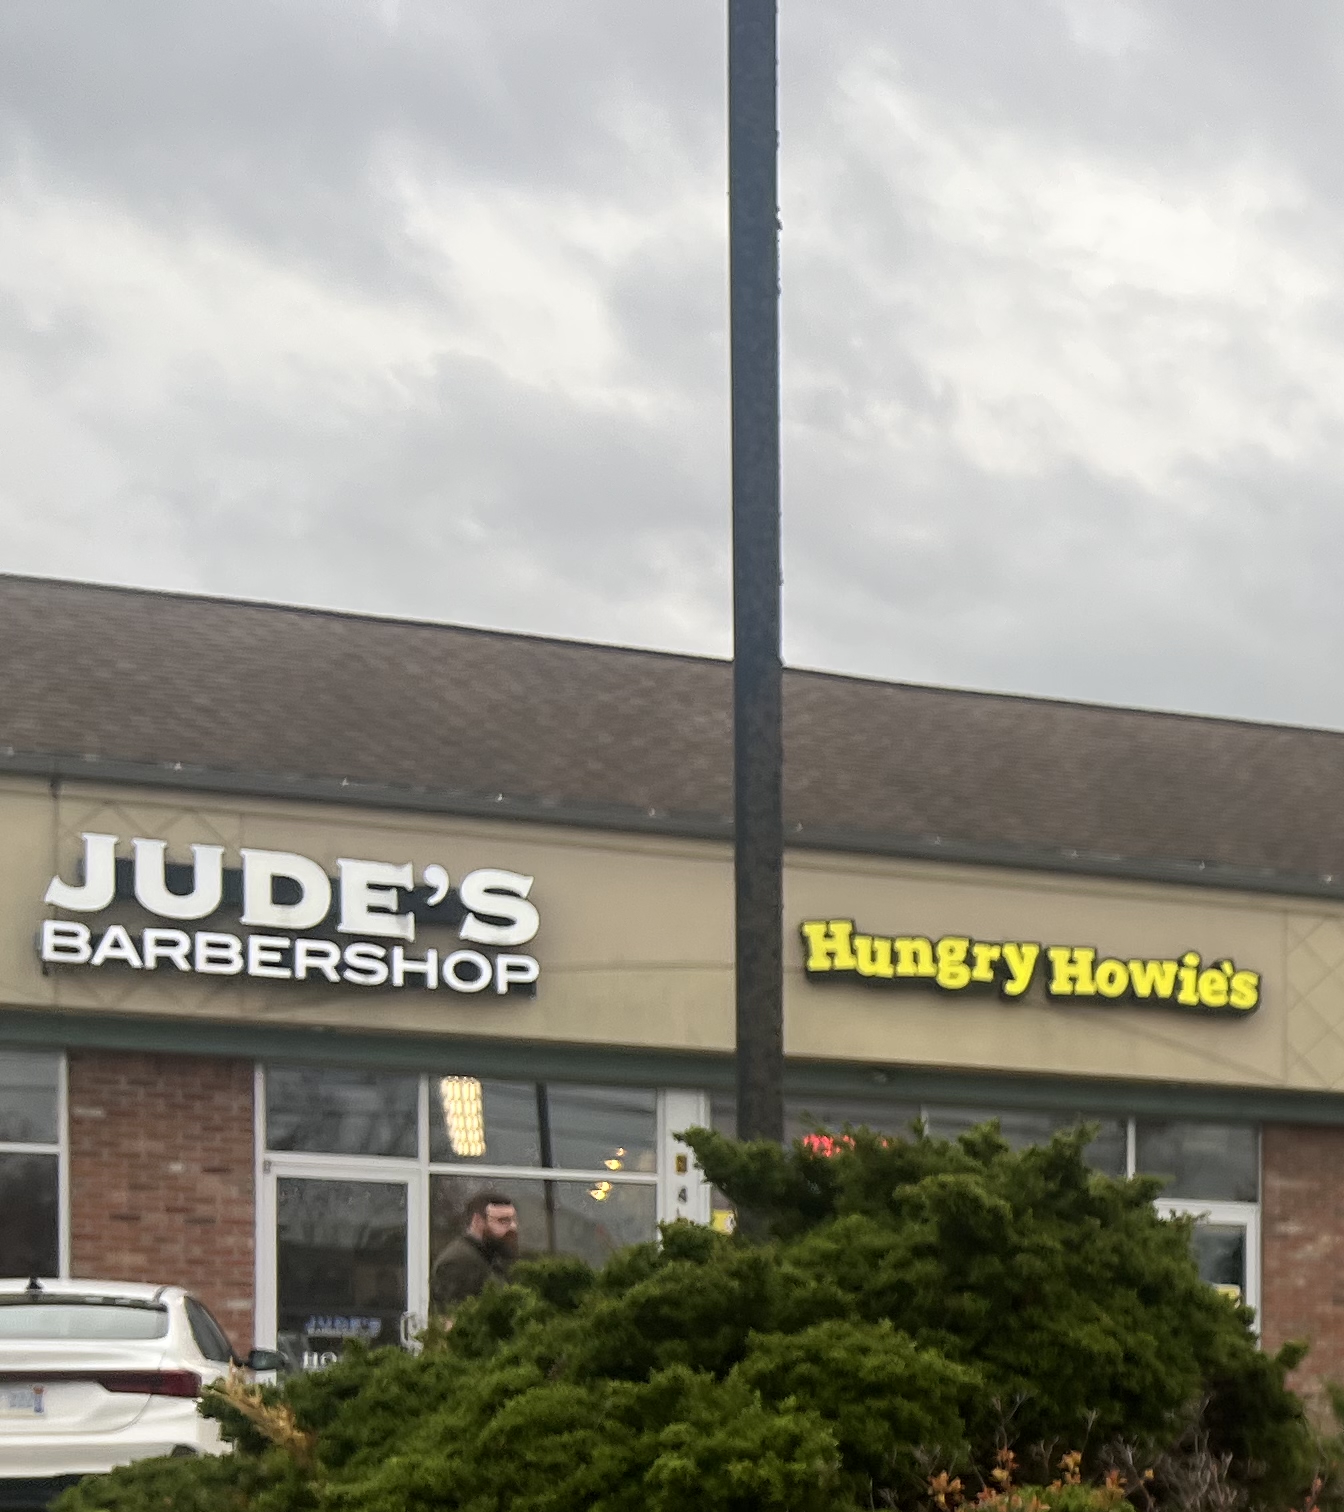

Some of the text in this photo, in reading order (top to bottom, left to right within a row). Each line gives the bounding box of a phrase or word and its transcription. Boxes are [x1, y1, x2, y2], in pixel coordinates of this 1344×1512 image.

[45, 832, 540, 946] JUDE'S
[41, 919, 540, 994] BARBERSHOP
[802, 919, 1260, 1010] Hungry Howie's
